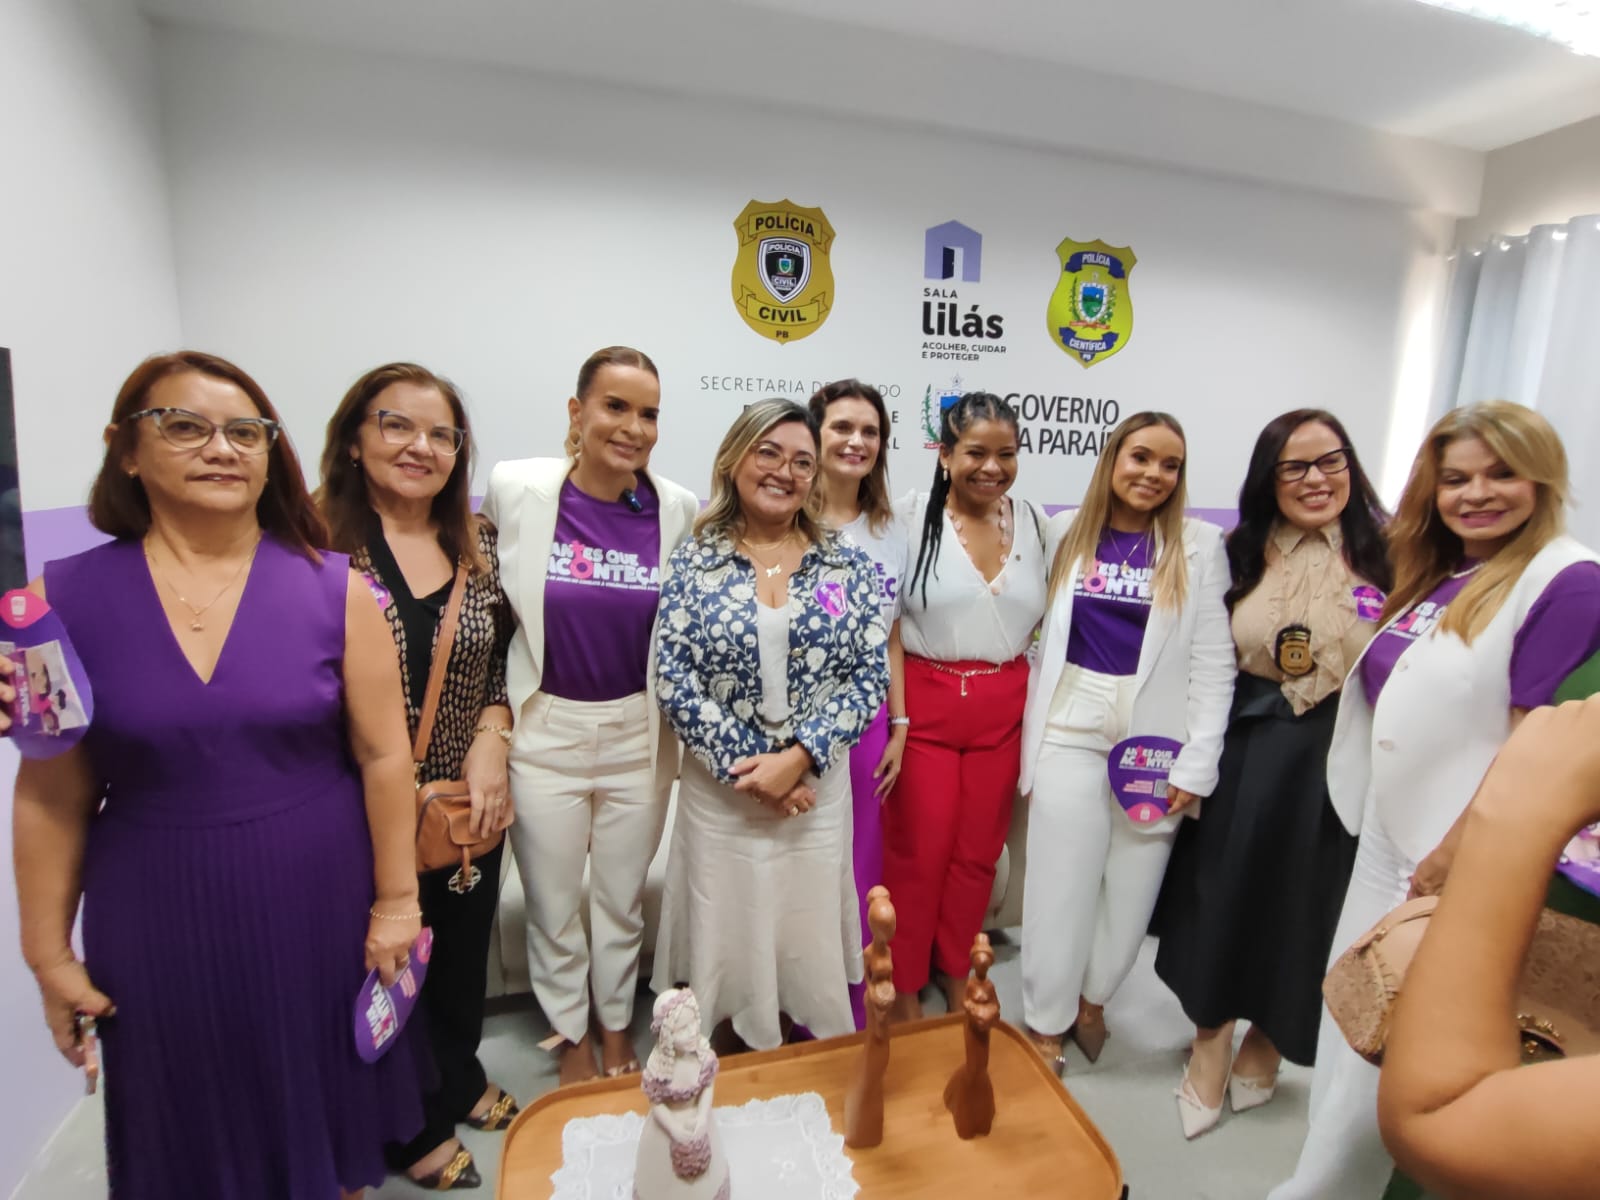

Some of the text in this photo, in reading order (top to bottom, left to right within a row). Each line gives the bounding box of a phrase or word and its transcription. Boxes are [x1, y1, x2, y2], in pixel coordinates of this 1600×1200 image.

[755, 212, 815, 236] POLÍCIA
[1082, 252, 1111, 266] POLÍCIA
[774, 277, 795, 286] CIVIL
[923, 287, 958, 299] SALA
[758, 306, 806, 322] CIVIL
[922, 301, 1004, 339] lilás
[776, 330, 789, 338] PB
[922, 342, 1007, 353] ACOLHER, CUIDAR
[1069, 337, 1107, 351] CIENTÍFICA
[922, 351, 980, 361] E PROTEGER
[700, 375, 805, 394] SECRETARIA
[1004, 392, 1120, 426] GOVERNO
[1038, 424, 1111, 457] PARAÍ
[551, 539, 639, 567] ANTES QUE
[547, 556, 660, 587] ACONTEÇA
[1154, 749, 1174, 759] QUE
